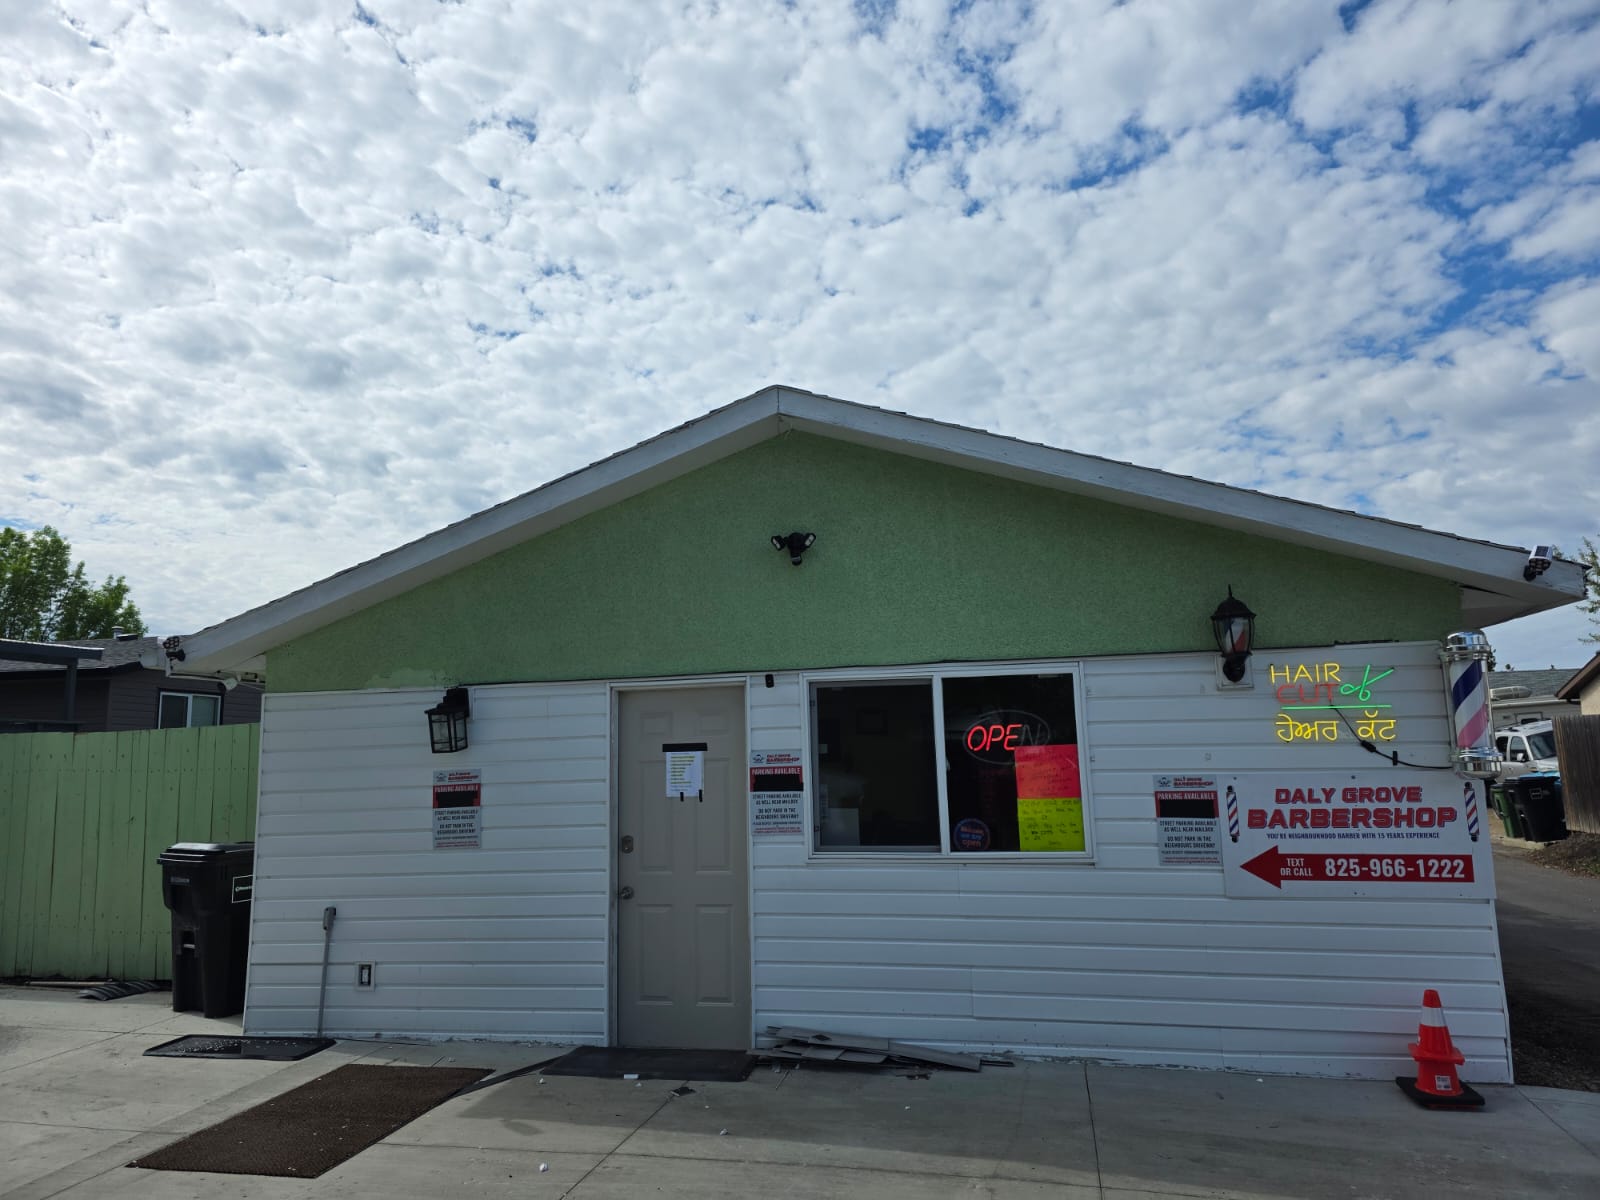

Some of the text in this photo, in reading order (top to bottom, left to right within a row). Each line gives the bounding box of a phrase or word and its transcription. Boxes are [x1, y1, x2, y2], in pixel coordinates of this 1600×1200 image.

[1270, 663, 1341, 684] HAIR
[1276, 683, 1340, 704] CUT
[1275, 709, 1397, 742] ਹੇਅਰ ਕੱਟ
[967, 723, 1042, 751] OPEN
[775, 767, 801, 775] AVAILABLE
[1157, 792, 1217, 800] PARKING AVAILABLE
[1275, 786, 1423, 804] DALY GROVE
[1247, 807, 1458, 829] BARBERSHOP
[1405, 831, 1440, 839] EXPERIENCE
[1280, 868, 1313, 876] OR CALL
[1286, 858, 1305, 867] TEXT
[1324, 858, 1465, 878] 825-966-1222
